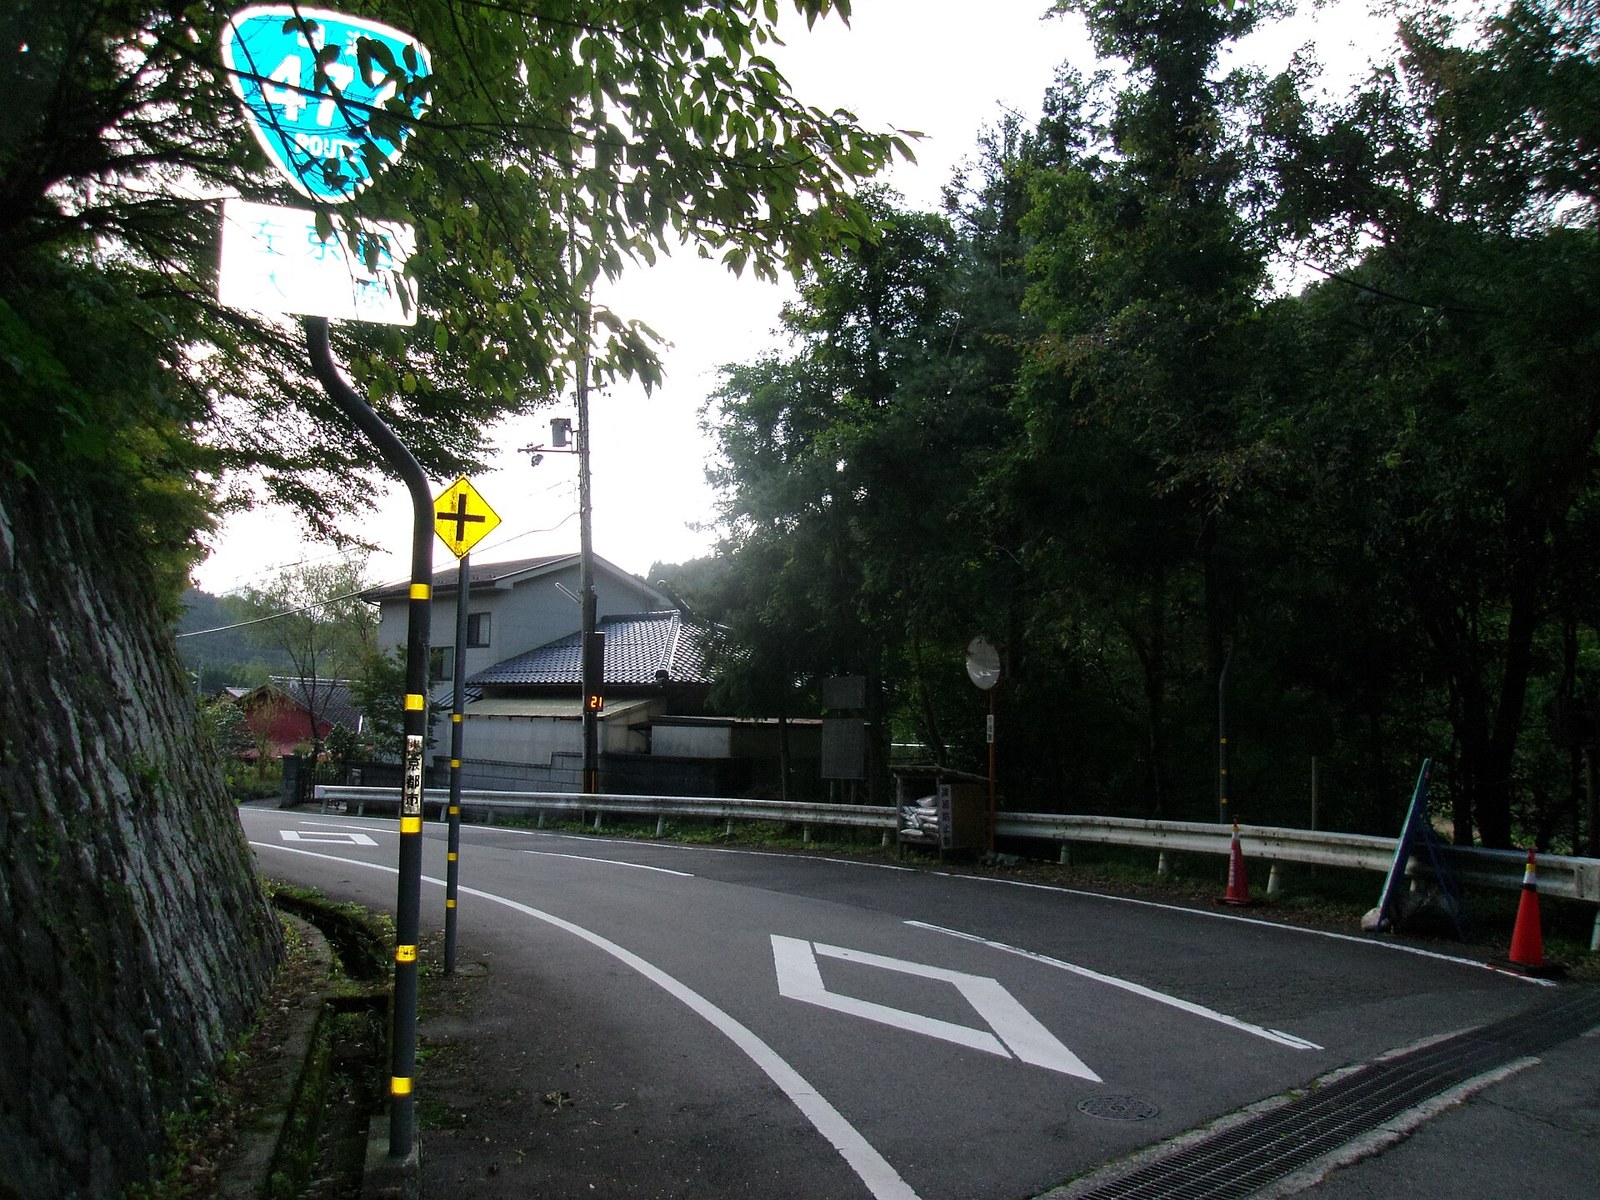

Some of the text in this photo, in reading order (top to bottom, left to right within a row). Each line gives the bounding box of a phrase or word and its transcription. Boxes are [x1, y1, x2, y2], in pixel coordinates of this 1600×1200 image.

[590, 695, 603, 708] 21
[406, 753, 421, 807] 京都市
